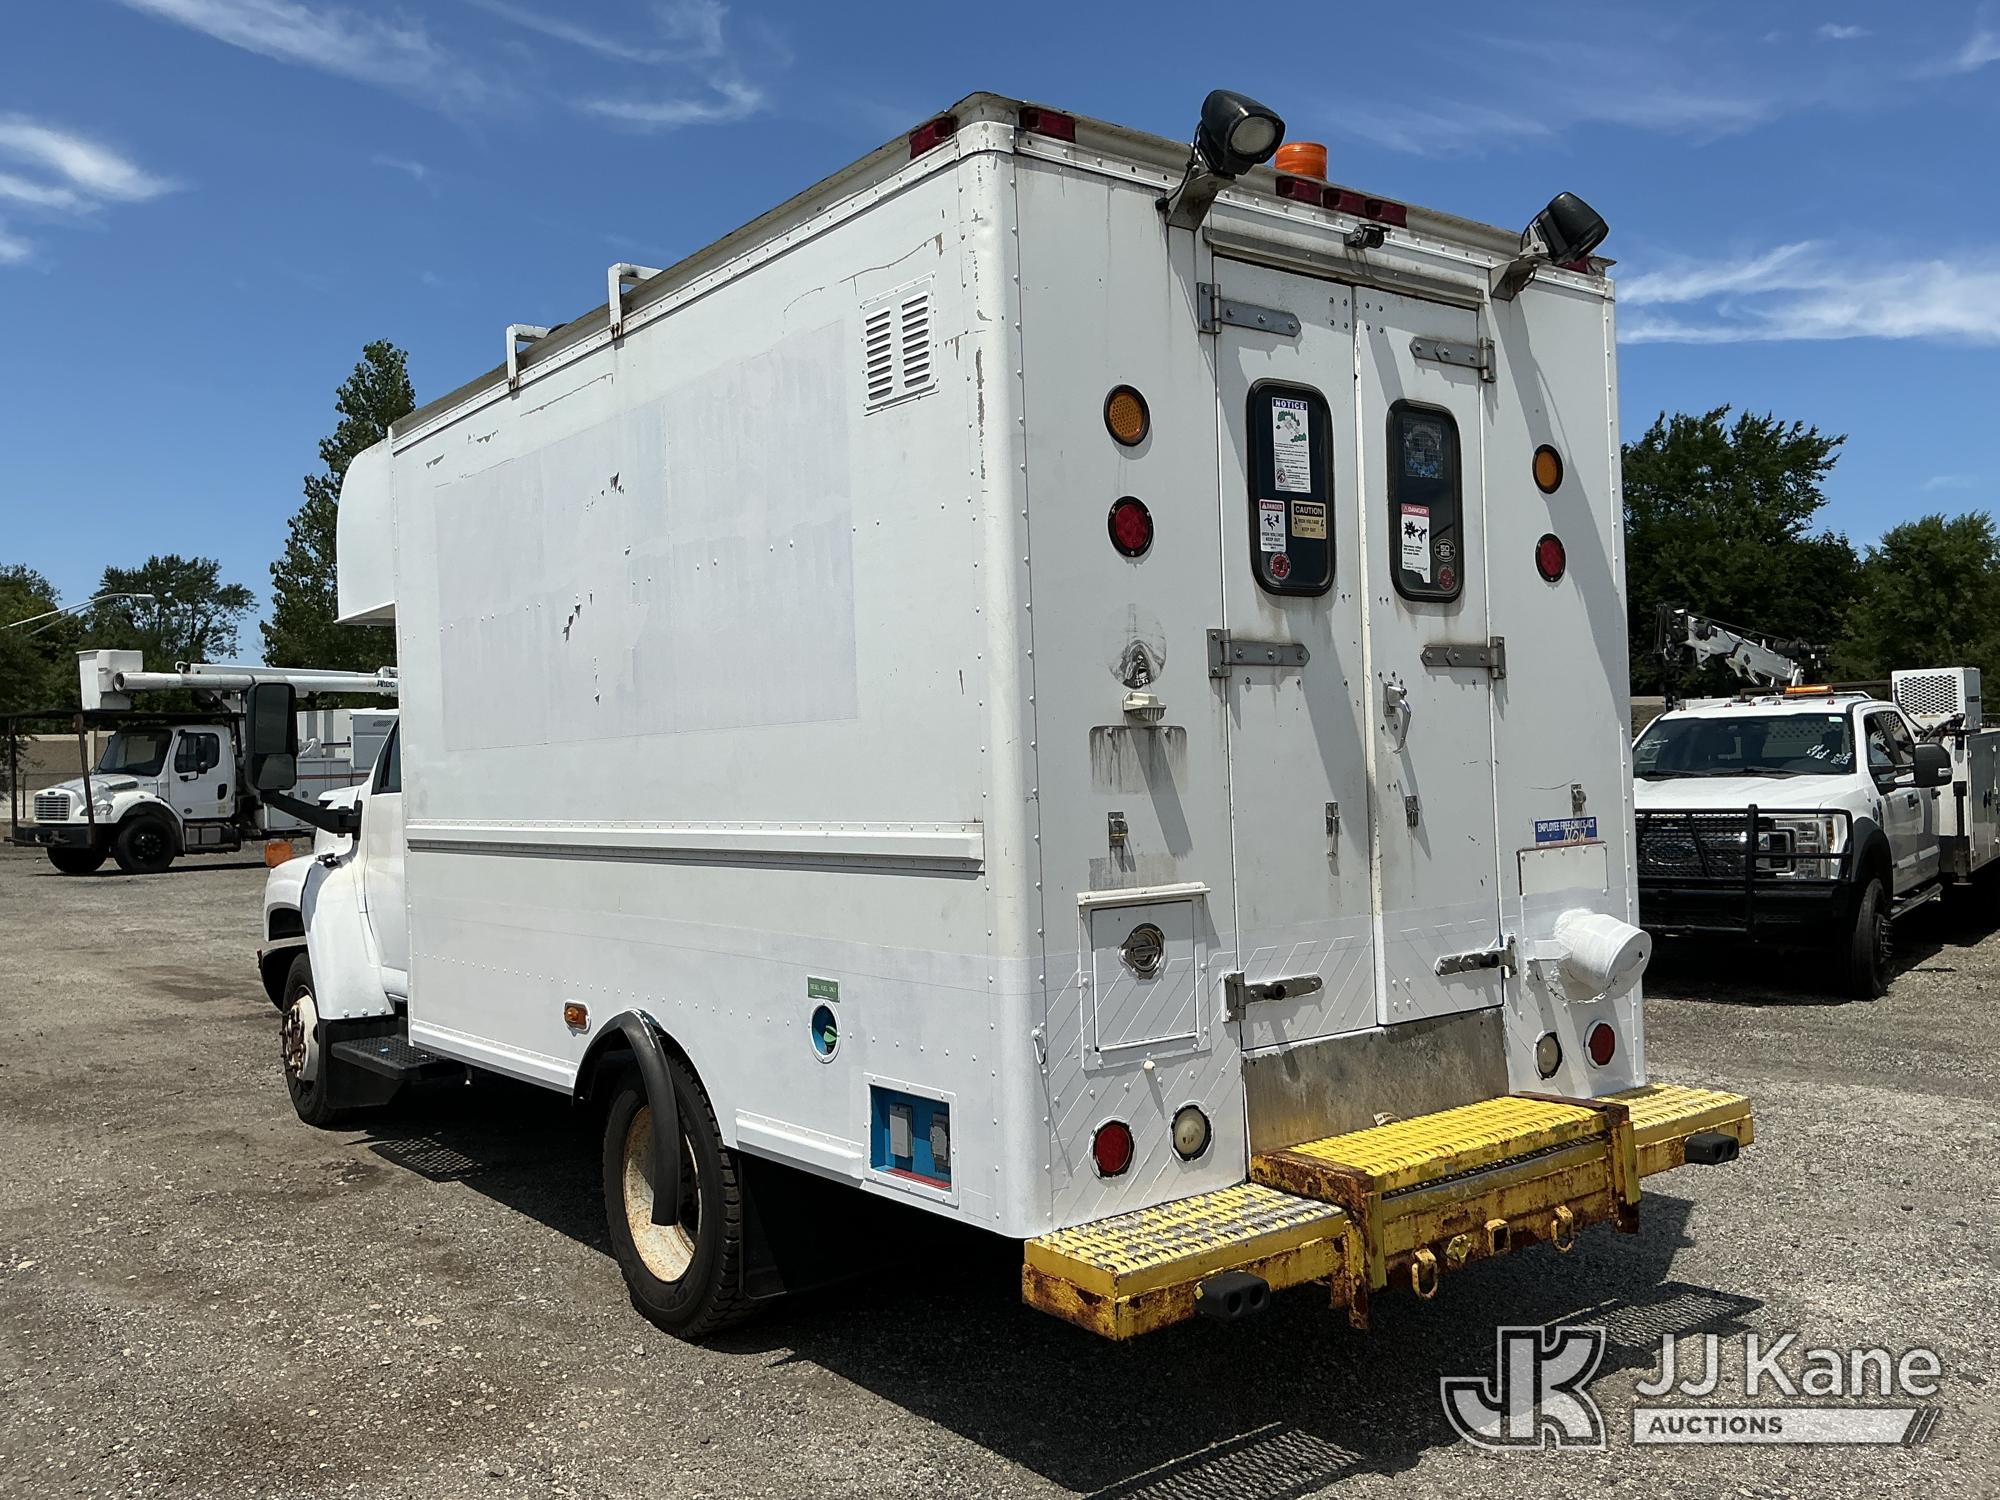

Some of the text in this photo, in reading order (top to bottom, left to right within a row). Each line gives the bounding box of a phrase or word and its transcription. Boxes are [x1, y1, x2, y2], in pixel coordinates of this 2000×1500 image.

[1275, 401, 1305, 410] NOTICE
[1267, 503, 1283, 512] DANGER
[1295, 506, 1323, 515] CAUTION
[1407, 506, 1427, 515] DANGER
[1537, 822, 1560, 833] EMPLOYEE
[1560, 820, 1571, 831] FREE
[1563, 825, 1587, 843] NOW
